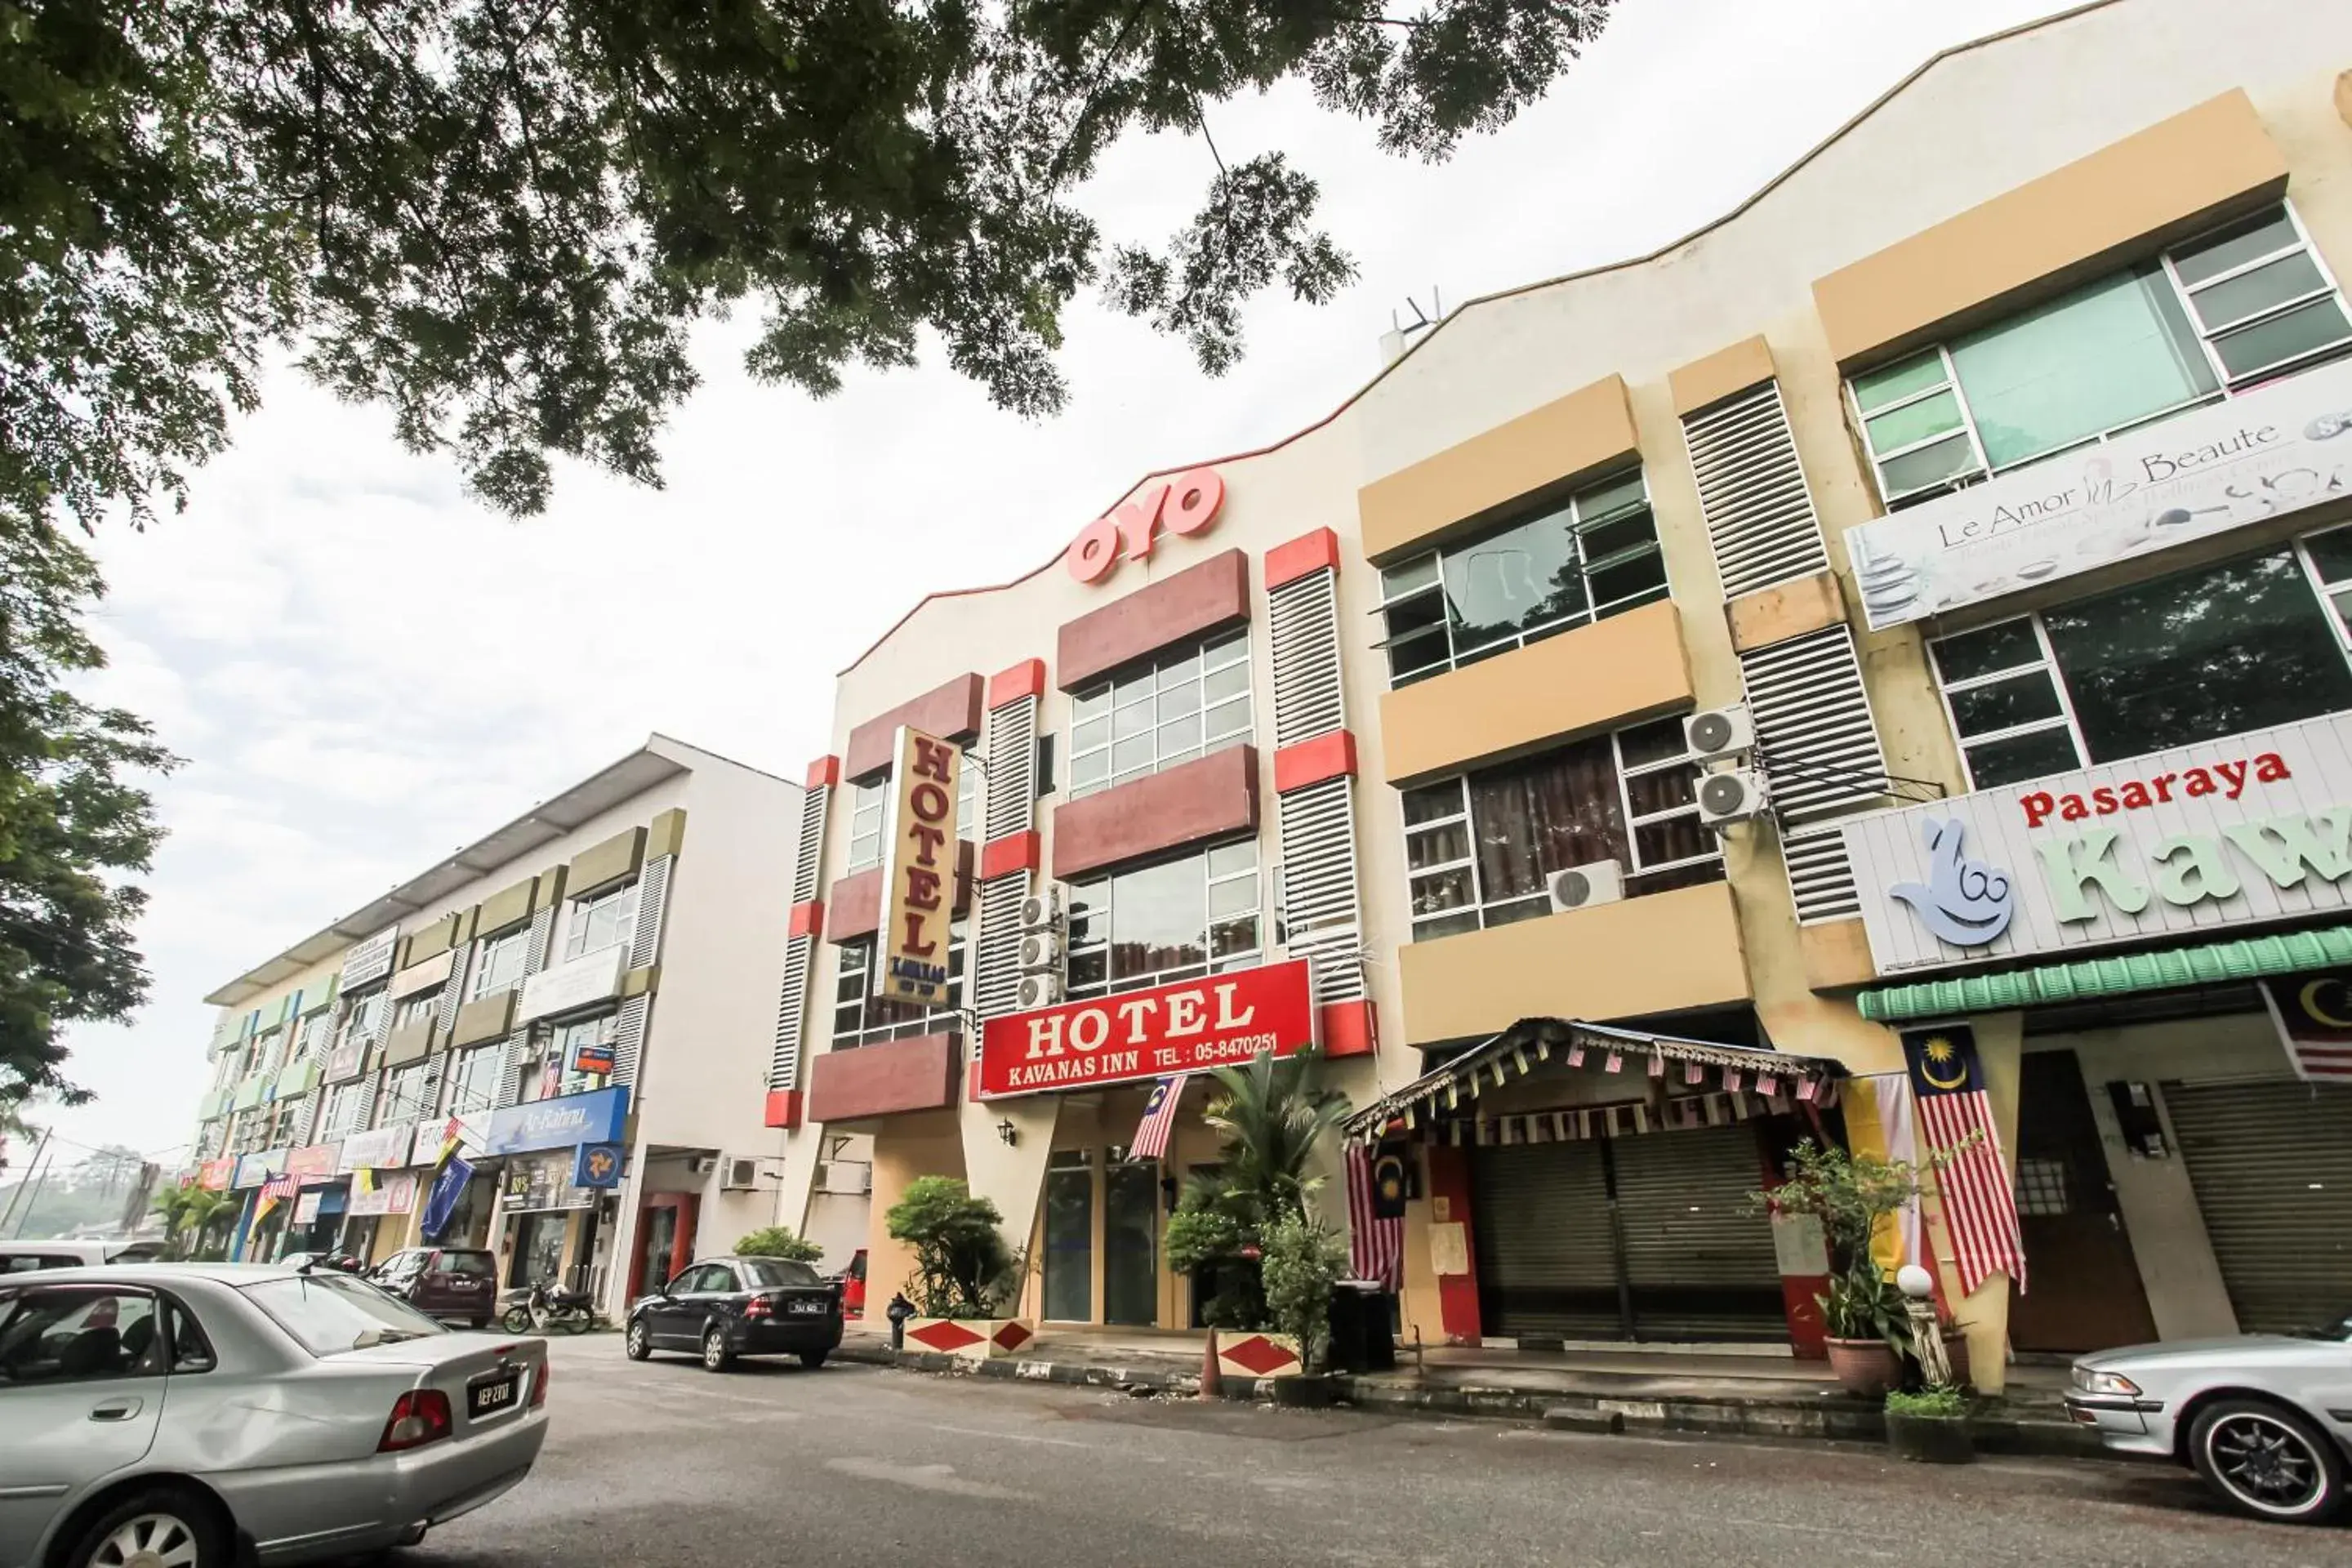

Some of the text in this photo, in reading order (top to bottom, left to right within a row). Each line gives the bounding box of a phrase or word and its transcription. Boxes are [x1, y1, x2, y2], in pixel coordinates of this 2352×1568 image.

[1067, 466, 1225, 586] OYO
[1939, 519, 1980, 549] Le
[1991, 488, 2075, 535] Amor
[2140, 423, 2282, 483] Beaute
[902, 736, 954, 957] HOTEL
[2019, 751, 2292, 828] Pasaraya
[2034, 805, 2352, 924] Kaw
[1009, 1059, 1095, 1087] KAVANAS
[1102, 1049, 1139, 1074] INN
[1154, 1048, 1181, 1067] TEL
[1196, 1033, 1278, 1062] 05-8470251
[1026, 982, 1254, 1059] HOTEL
